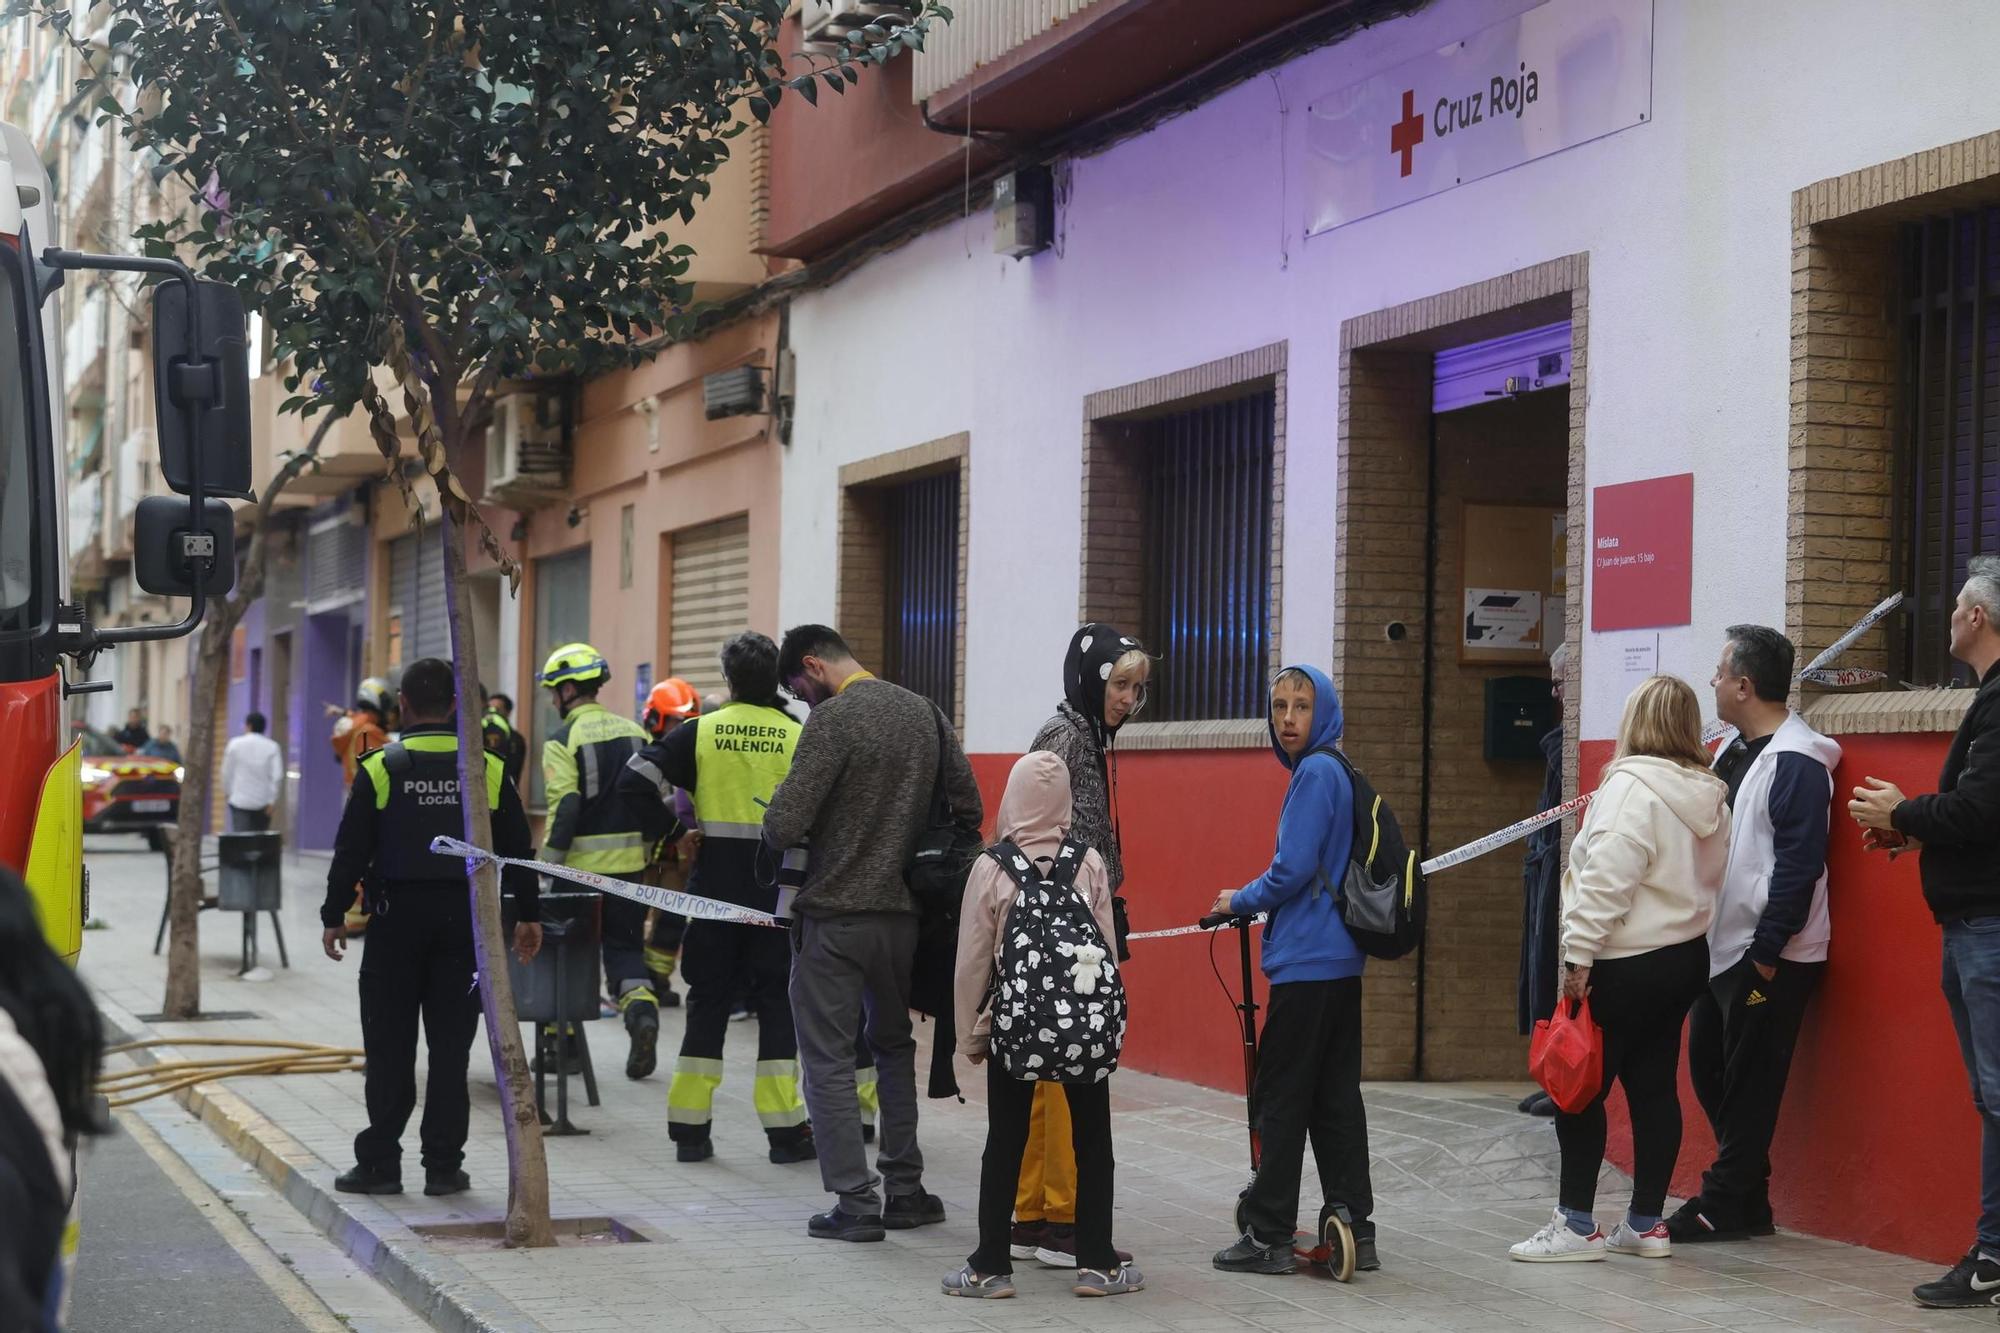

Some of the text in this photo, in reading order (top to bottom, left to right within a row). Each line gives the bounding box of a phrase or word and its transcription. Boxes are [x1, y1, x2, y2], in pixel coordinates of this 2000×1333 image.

[1434, 61, 1539, 137] Cruz Roja
[1597, 536, 1619, 549] Mislata
[1637, 553, 1644, 563] 15
[1644, 552, 1655, 564] bajo
[715, 724, 787, 739] BOMBERS
[715, 738, 784, 754] VALÈNCIA
[404, 780, 461, 794] POLICI
[418, 795, 459, 805] LOCAL
